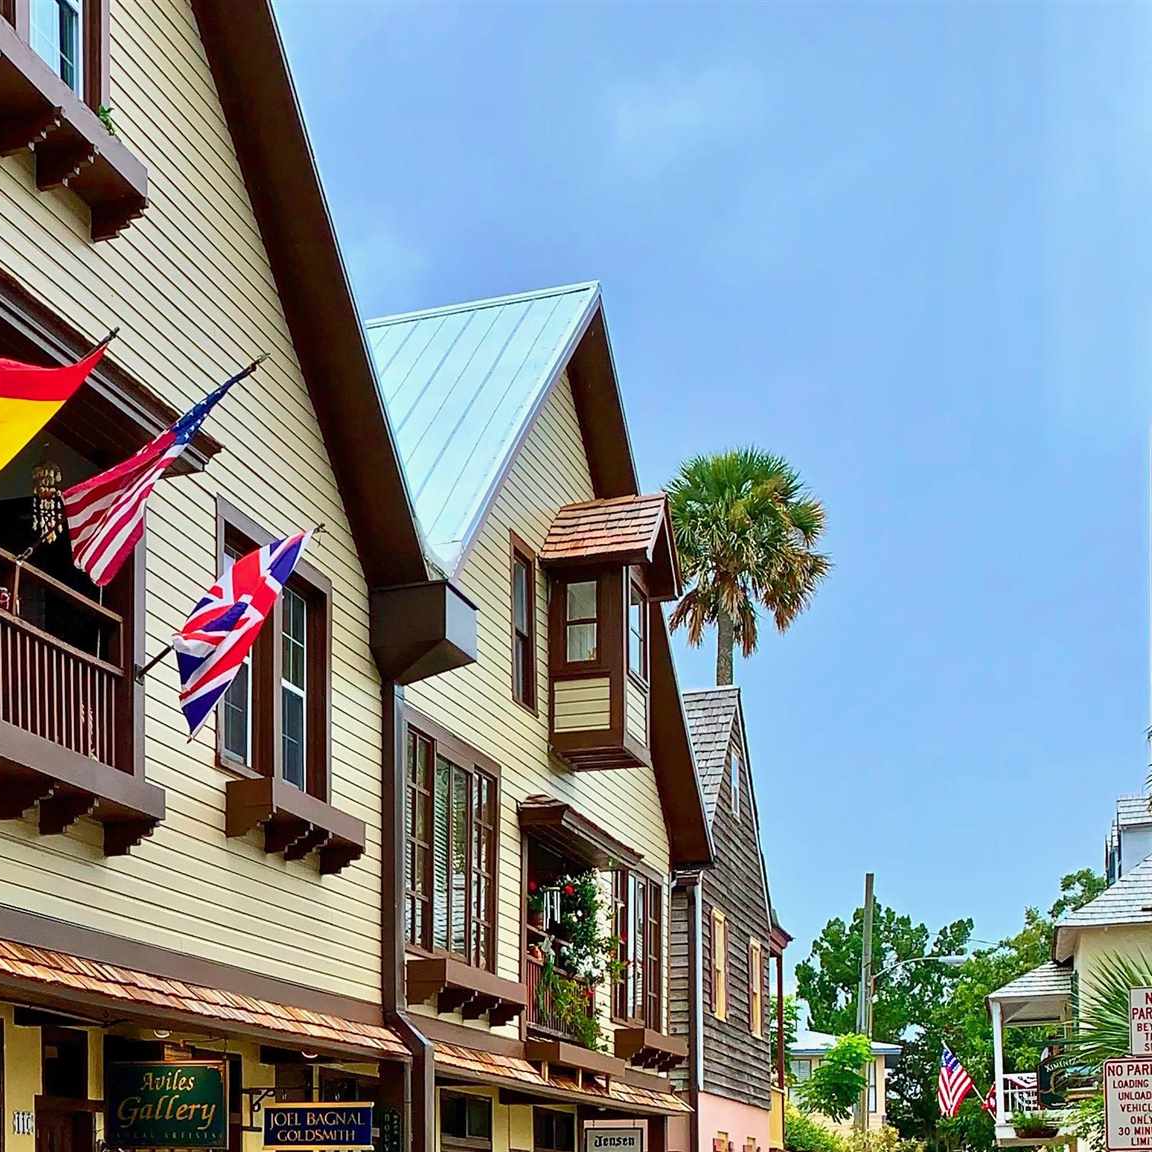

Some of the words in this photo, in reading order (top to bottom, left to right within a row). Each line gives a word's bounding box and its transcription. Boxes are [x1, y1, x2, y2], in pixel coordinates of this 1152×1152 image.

[1108, 1065, 1123, 1078] NO
[139, 1068, 196, 1092] Aviles
[1113, 1080, 1150, 1089] LOADING
[116, 1094, 217, 1131] Gallery
[269, 1111, 303, 1130] JOEL
[306, 1111, 366, 1127] BAGNAL
[277, 1129, 356, 1142] GOLDSMITH
[1118, 1126, 1130, 1136] 30
[1134, 1126, 1152, 1136] MIN
[594, 1135, 635, 1148] Jensen
